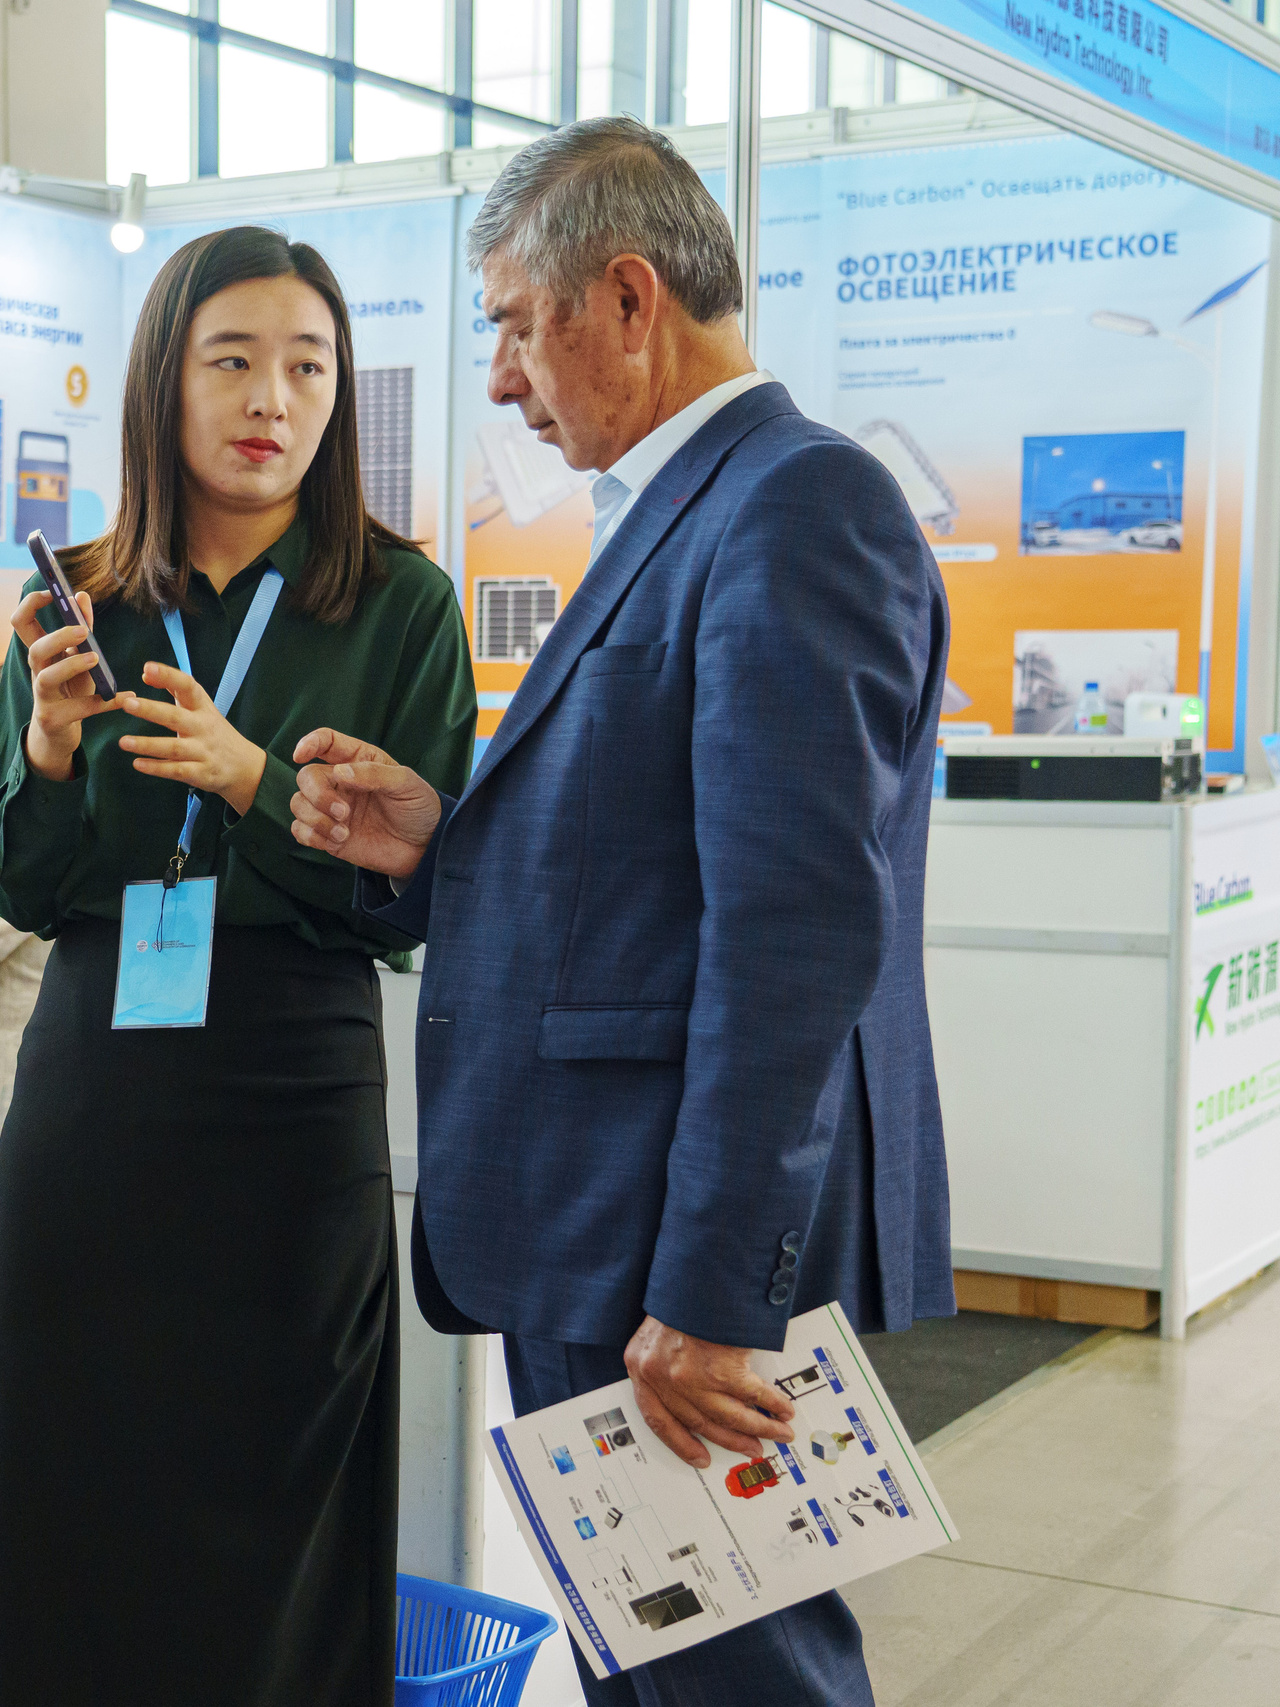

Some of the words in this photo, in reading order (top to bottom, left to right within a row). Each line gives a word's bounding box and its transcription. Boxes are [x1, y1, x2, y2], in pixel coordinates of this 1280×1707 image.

[1006, 0, 1031, 38] New
[1035, 12, 1069, 58] Hydro
[1075, 34, 1133, 95] Technology
[981, 175, 1086, 199] Освещать
[838, 231, 1178, 277] ФОТОЭЛЕКТРИЧЕСКОЕ
[837, 270, 1016, 303] ОСВЕЩЕНИЕ
[31, 324, 83, 347] энергии
[1194, 876, 1216, 914] Blue
[1218, 871, 1252, 906] Carbon
